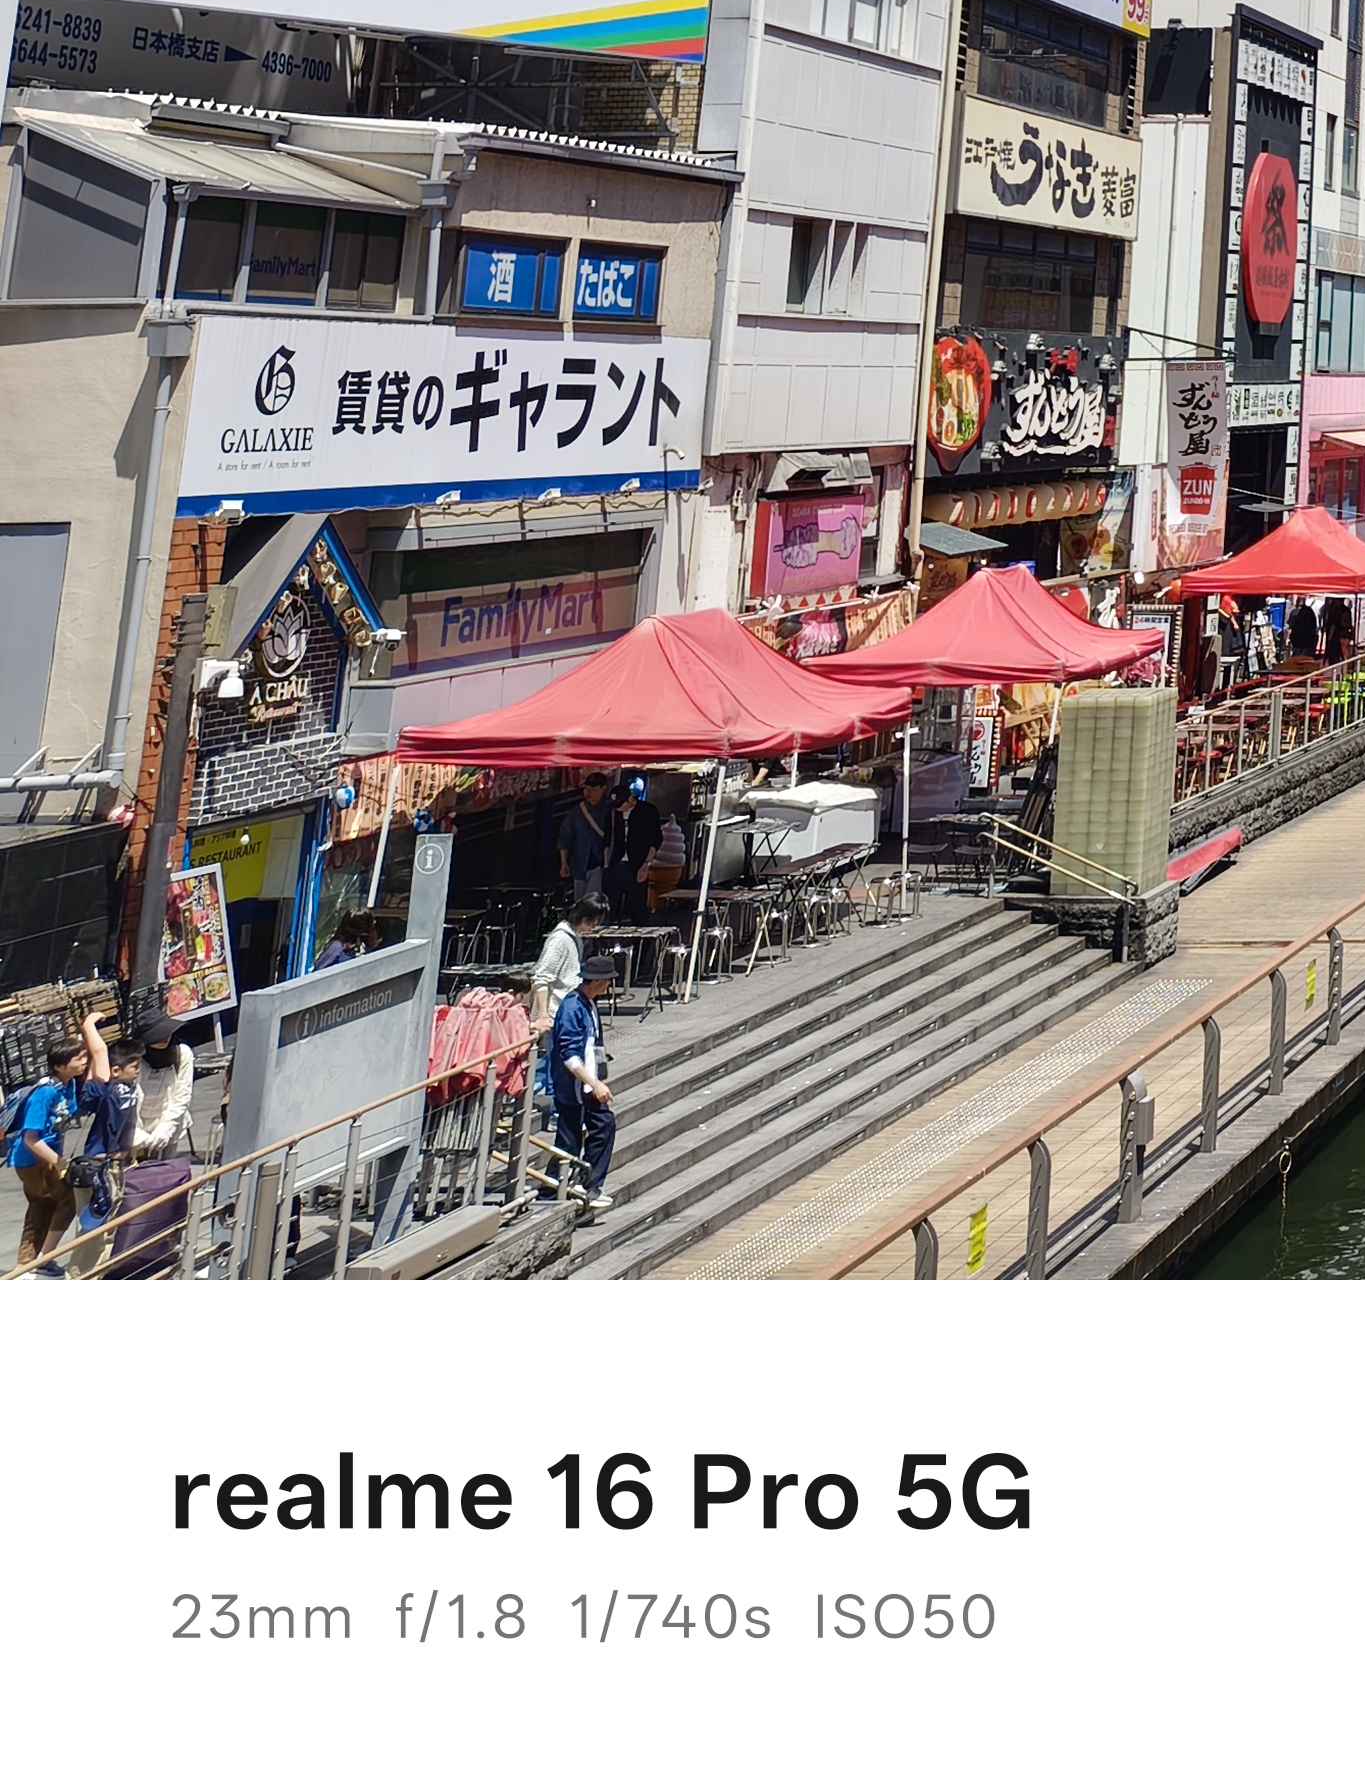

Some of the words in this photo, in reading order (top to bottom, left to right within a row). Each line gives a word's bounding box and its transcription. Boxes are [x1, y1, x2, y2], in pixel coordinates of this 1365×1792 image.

[133, 27, 220, 63] 日本橋支店
[262, 50, 331, 83] 4396-7000
[990, 122, 1098, 218] うなぎ
[487, 252, 516, 304] 酒
[579, 258, 635, 309] たばこ
[332, 348, 681, 453] 賃貸のギャラント
[1183, 479, 1213, 496] ZUN
[440, 582, 602, 648] FamilyMart
[199, 842, 263, 867] RESTAURANT
[320, 985, 393, 1028] information
